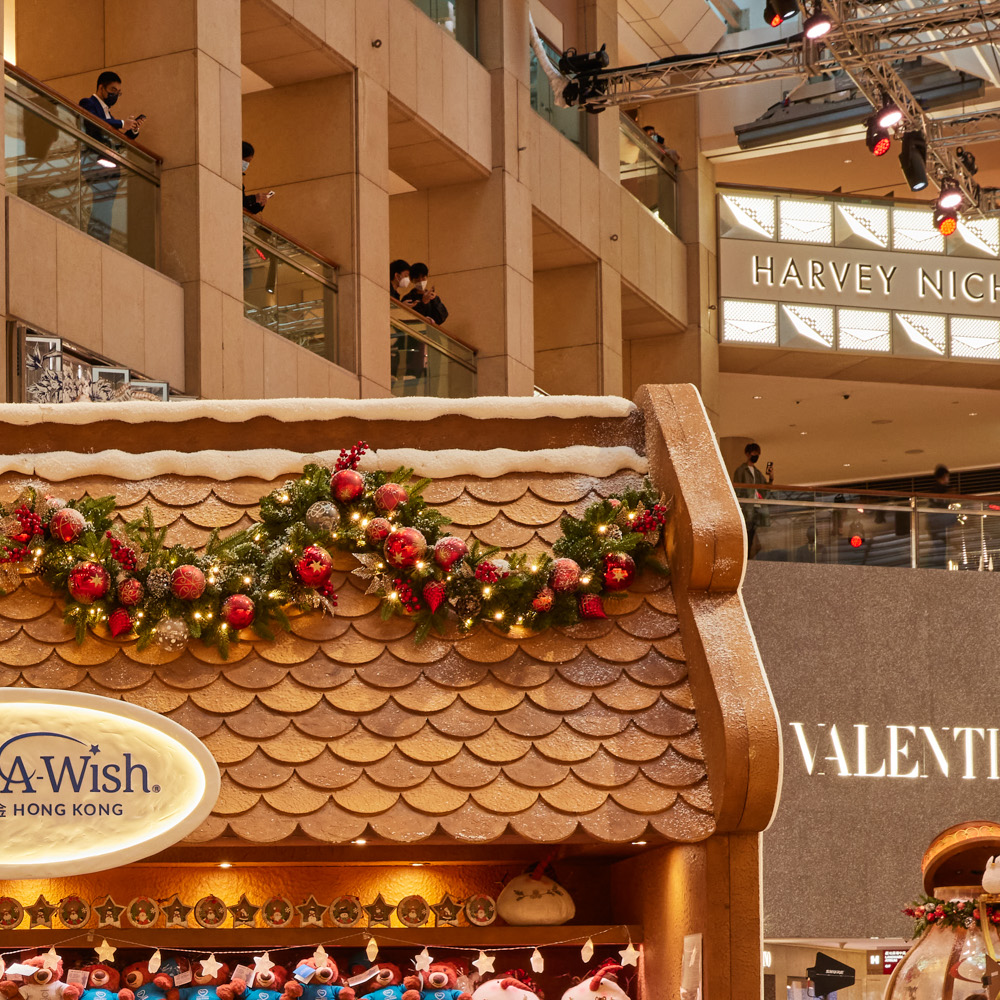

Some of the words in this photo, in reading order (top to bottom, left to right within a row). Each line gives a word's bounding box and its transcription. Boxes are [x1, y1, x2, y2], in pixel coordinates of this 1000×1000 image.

[752, 255, 897, 295] HARVEY
[789, 722, 1000, 779] VALENTI
[13, 803, 66, 816] HONG
[73, 803, 123, 816] KONG
